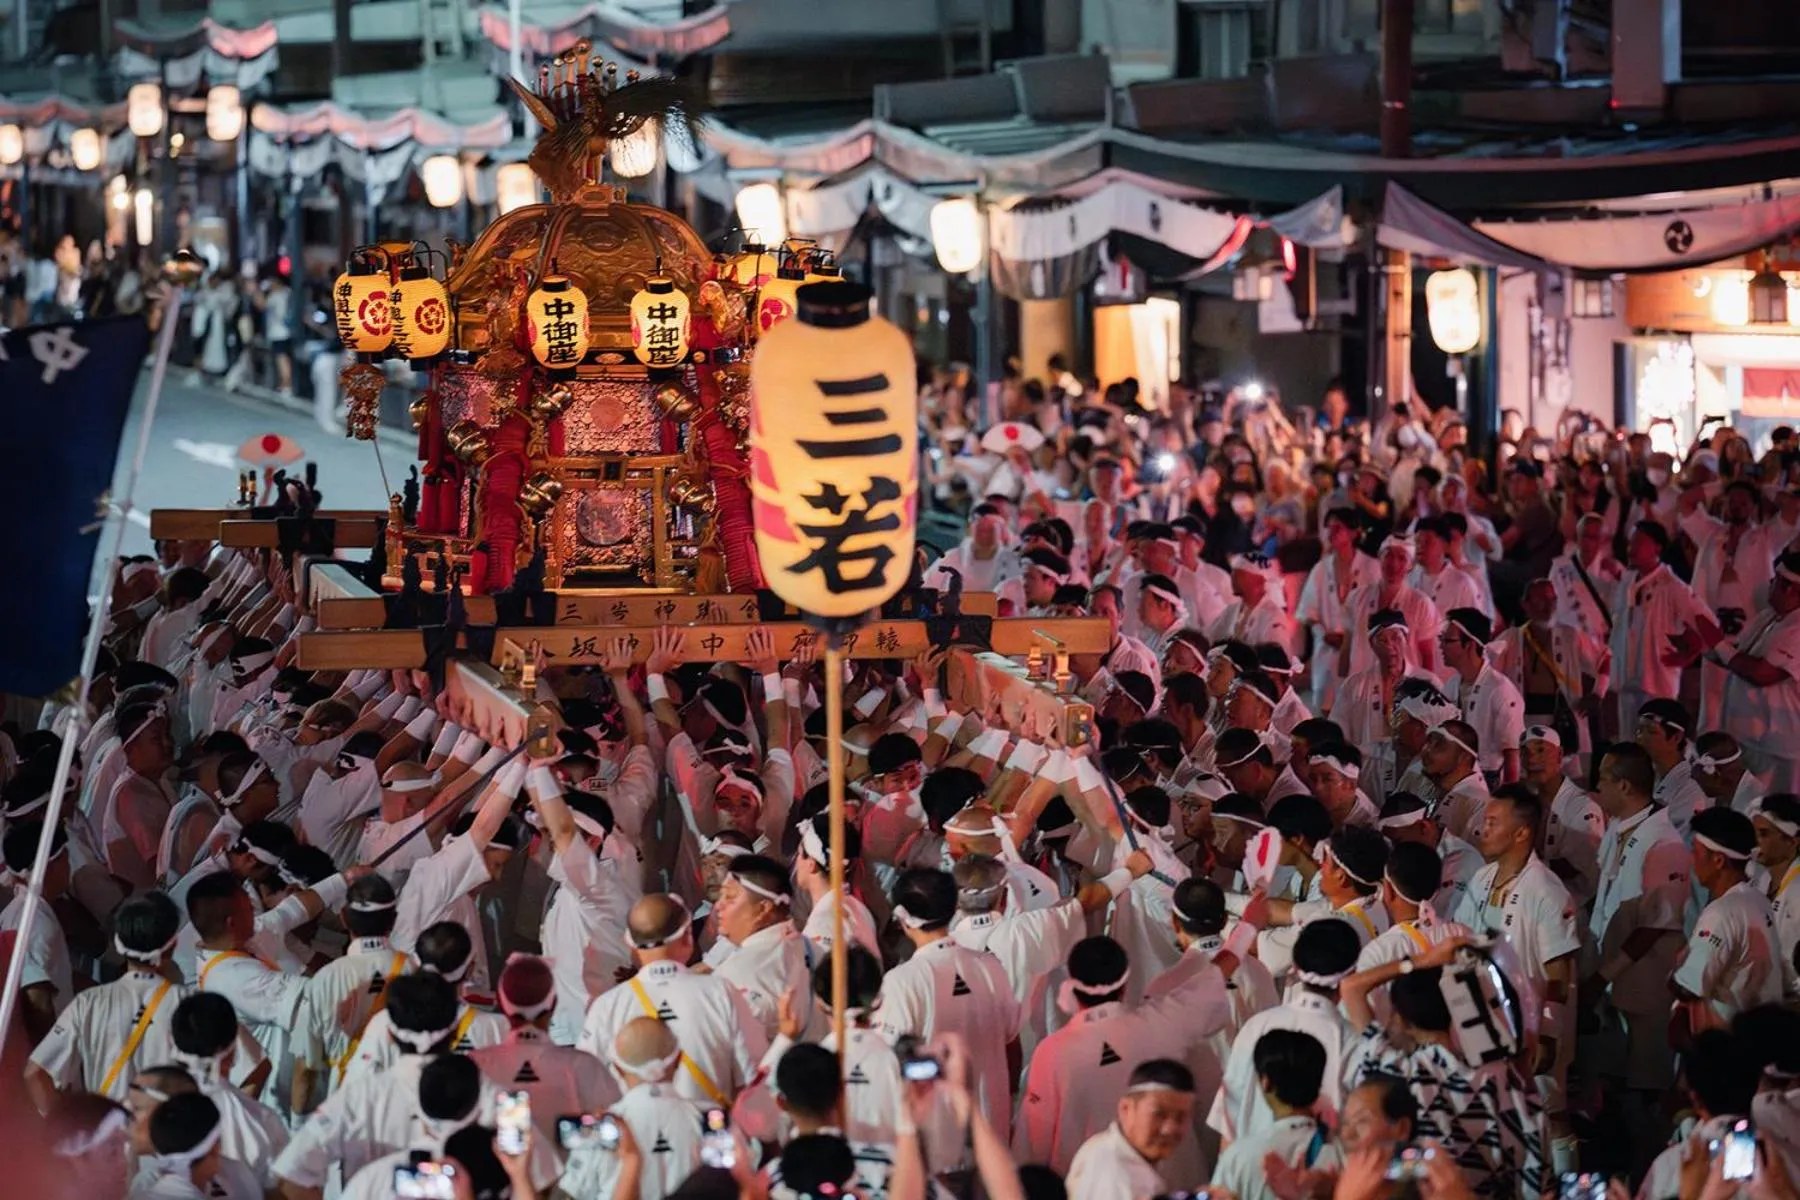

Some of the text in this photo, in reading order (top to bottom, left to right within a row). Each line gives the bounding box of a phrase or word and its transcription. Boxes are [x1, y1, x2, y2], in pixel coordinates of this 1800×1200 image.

[542, 298, 579, 363] 中御座
[646, 302, 680, 364] 中御座
[784, 372, 902, 594] 三若
